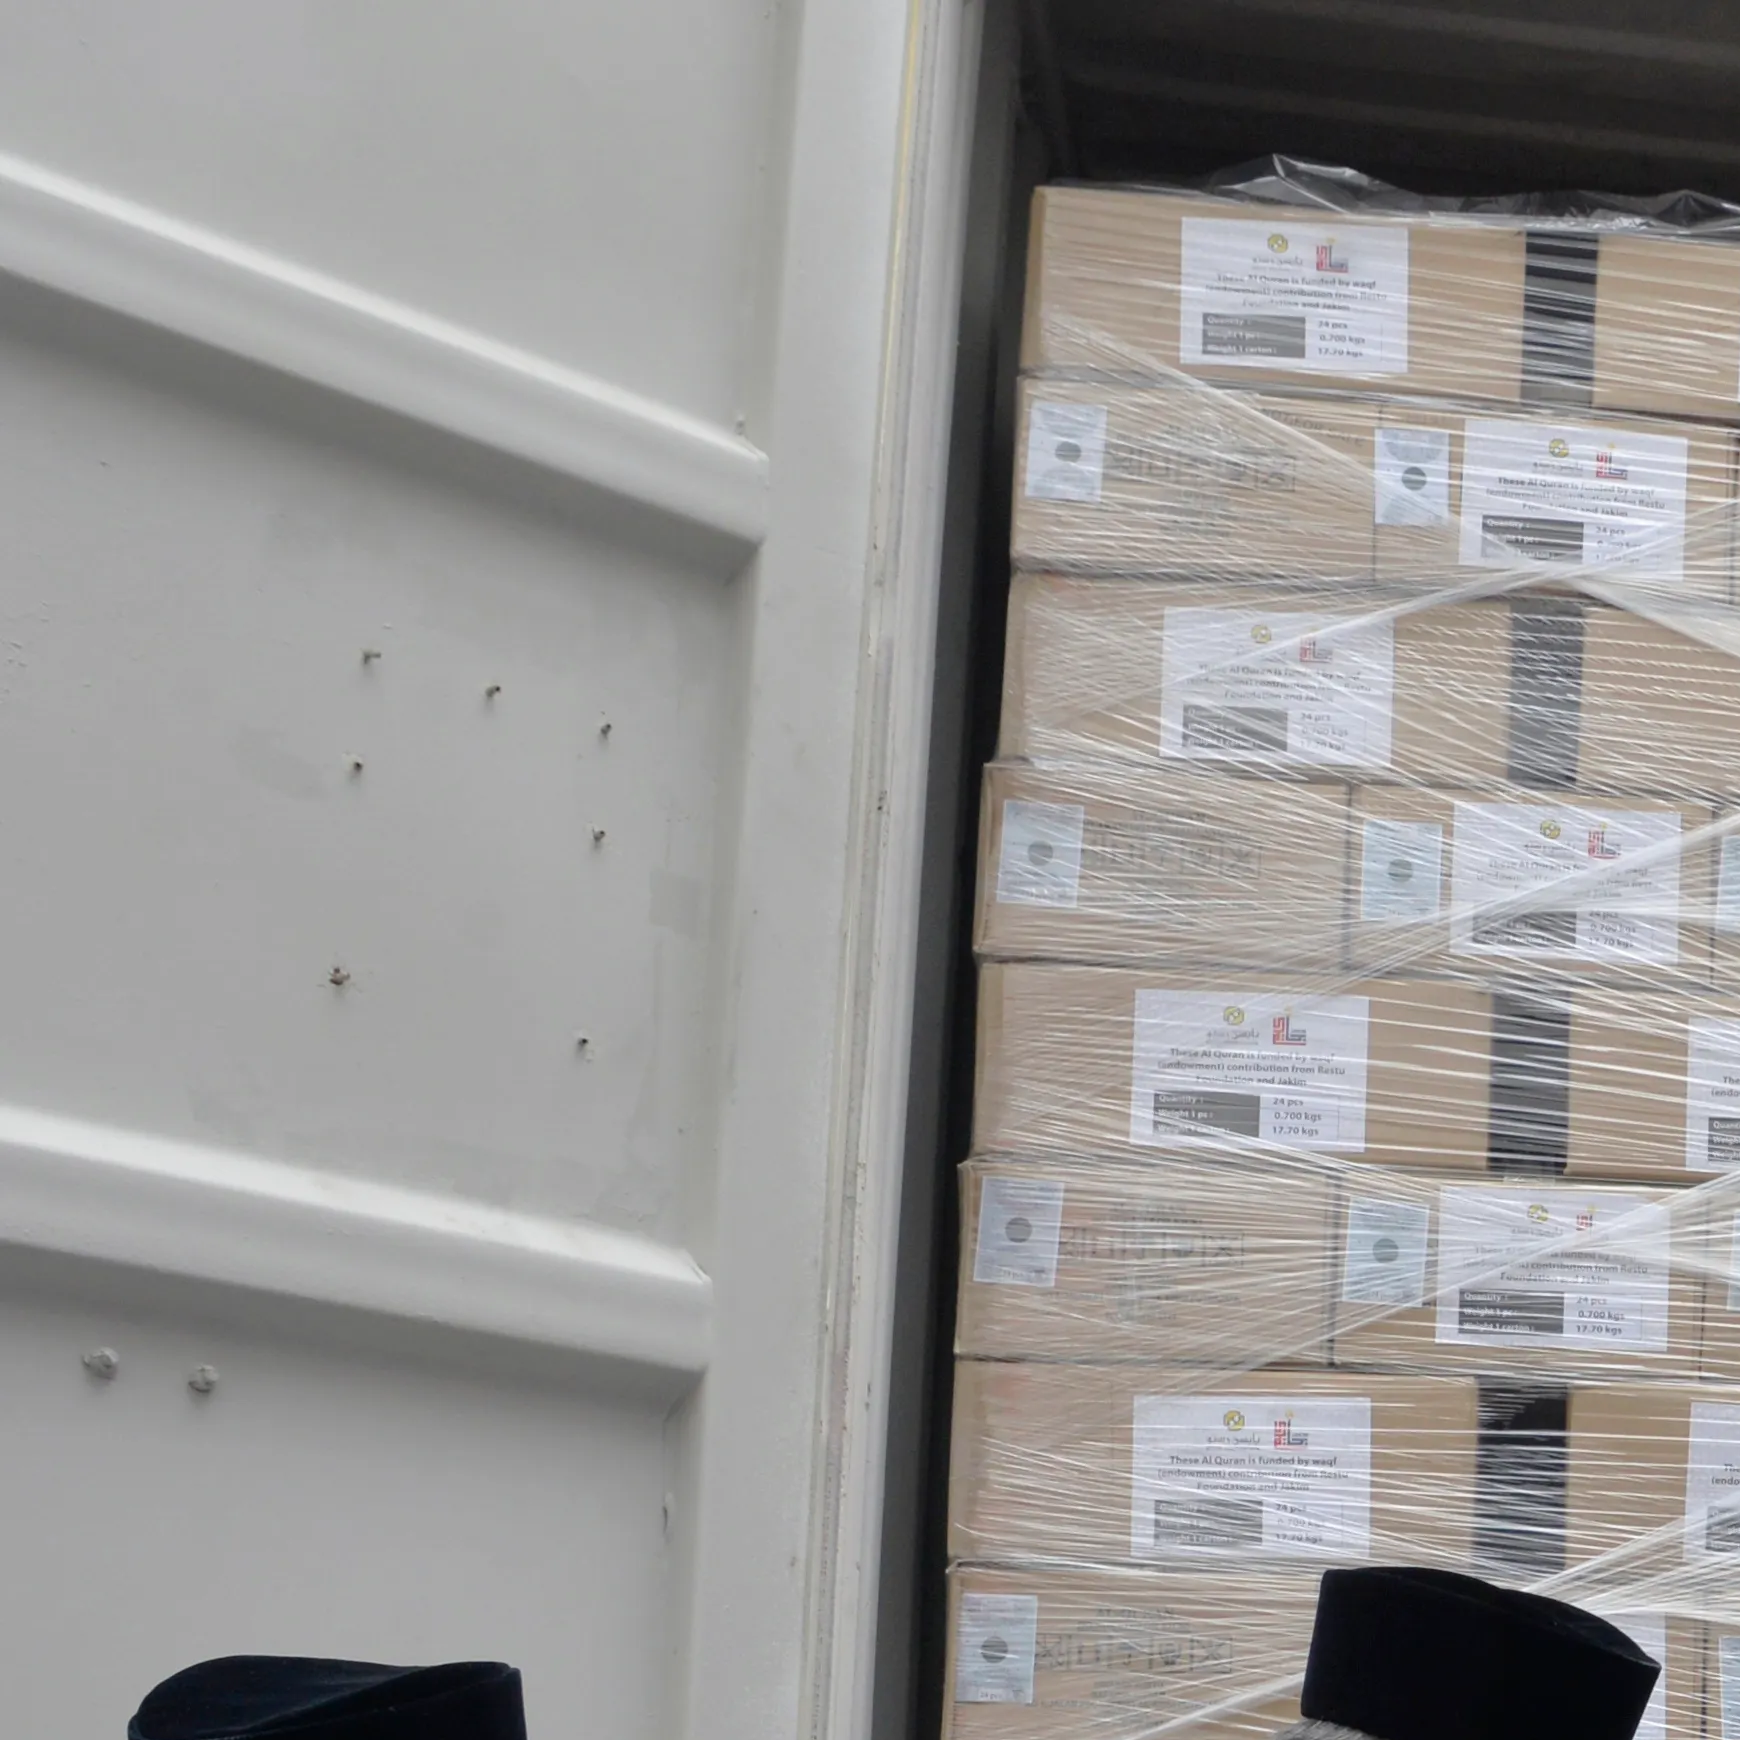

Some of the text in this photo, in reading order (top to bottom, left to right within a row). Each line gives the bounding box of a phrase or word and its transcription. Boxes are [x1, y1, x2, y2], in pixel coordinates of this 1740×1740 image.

[1213, 1050, 1244, 1059] Quran
[1227, 1062, 1288, 1072] contribution
[1291, 1065, 1314, 1073] from
[1274, 1111, 1321, 1122] 0.700 kgs
[1273, 1126, 1318, 1136] 17.70 kgs
[1214, 1456, 1245, 1464] Quran
